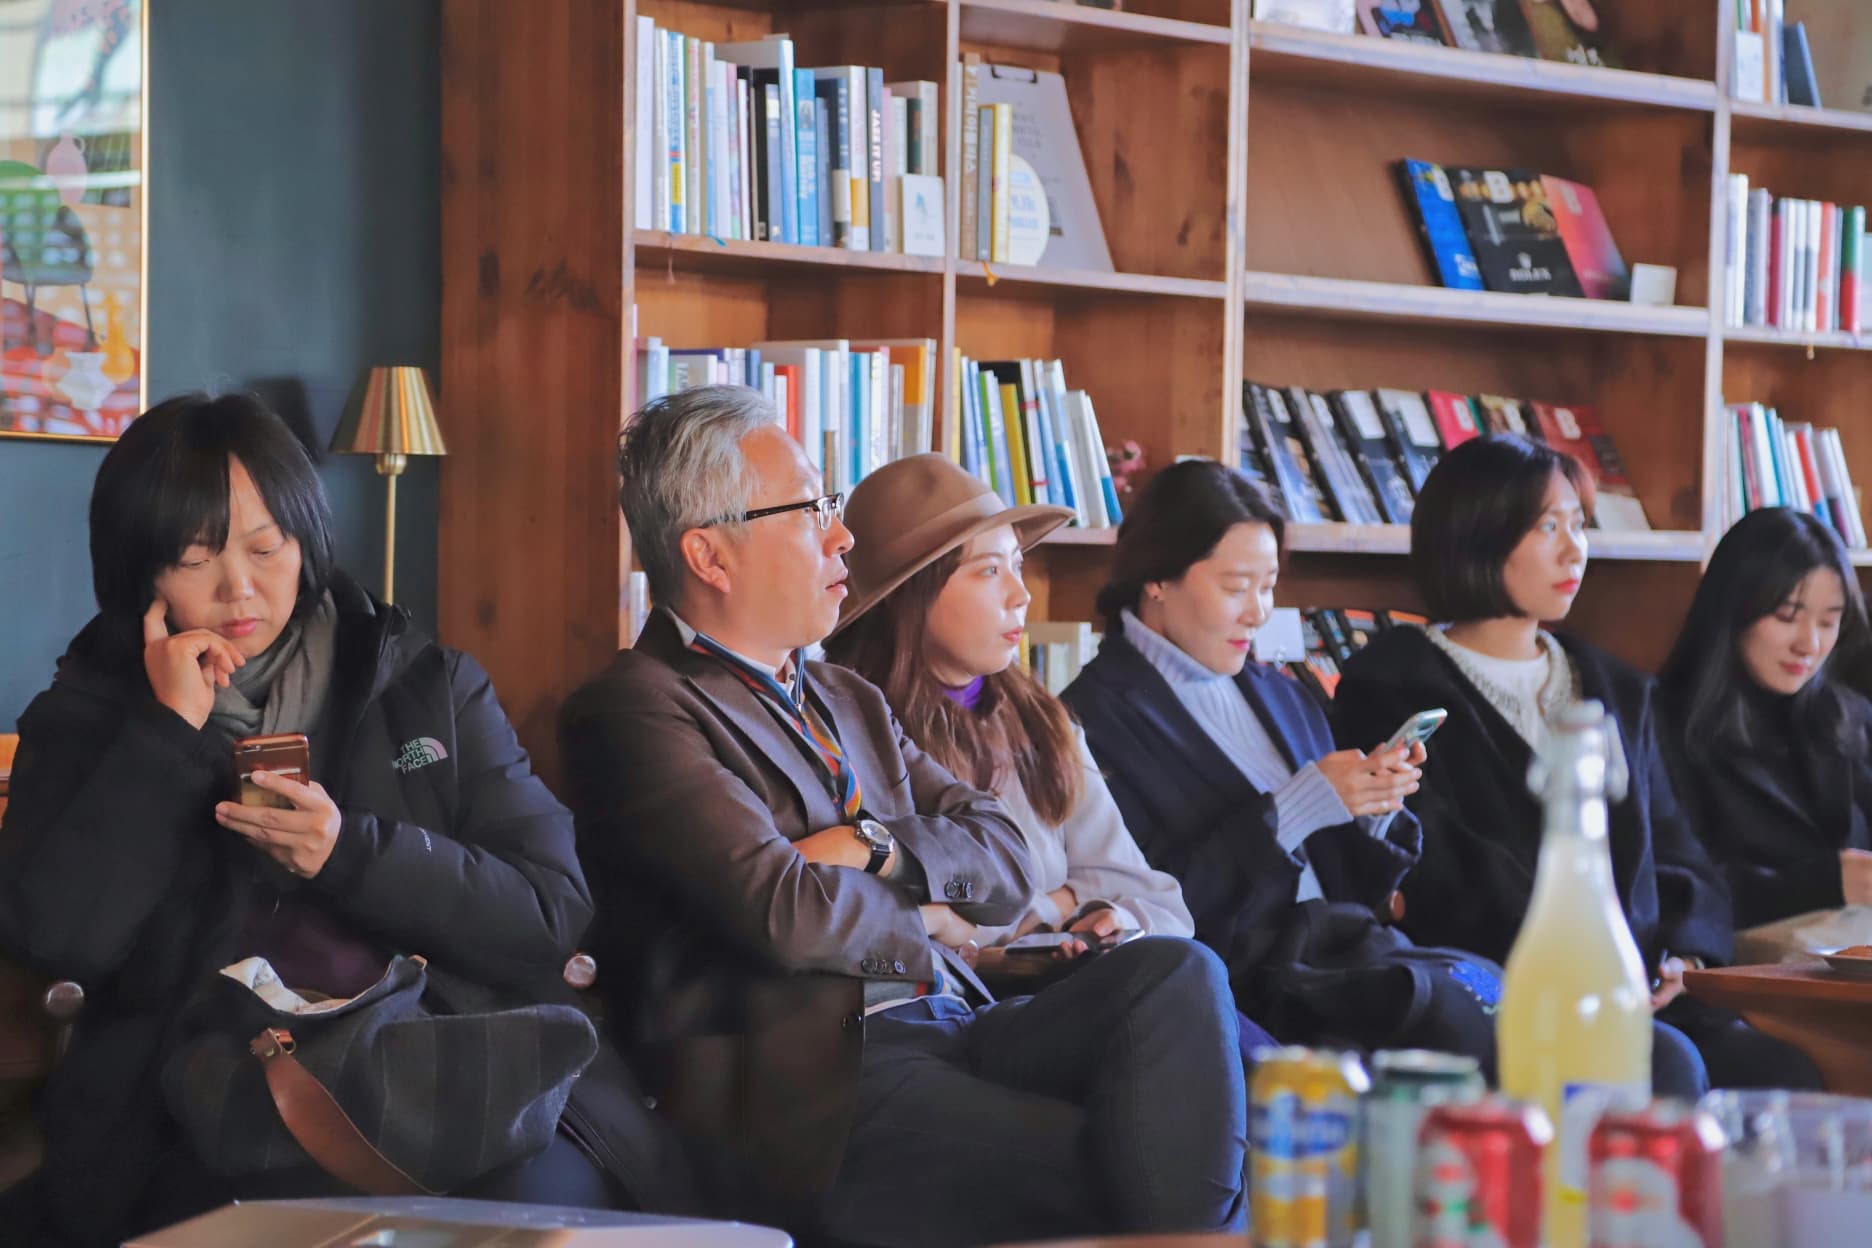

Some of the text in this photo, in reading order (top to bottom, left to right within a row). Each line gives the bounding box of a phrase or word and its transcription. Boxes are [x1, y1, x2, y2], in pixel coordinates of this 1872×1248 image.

[400, 738, 421, 753] THE
[392, 747, 424, 769] NORTH
[401, 758, 428, 774] FACE
